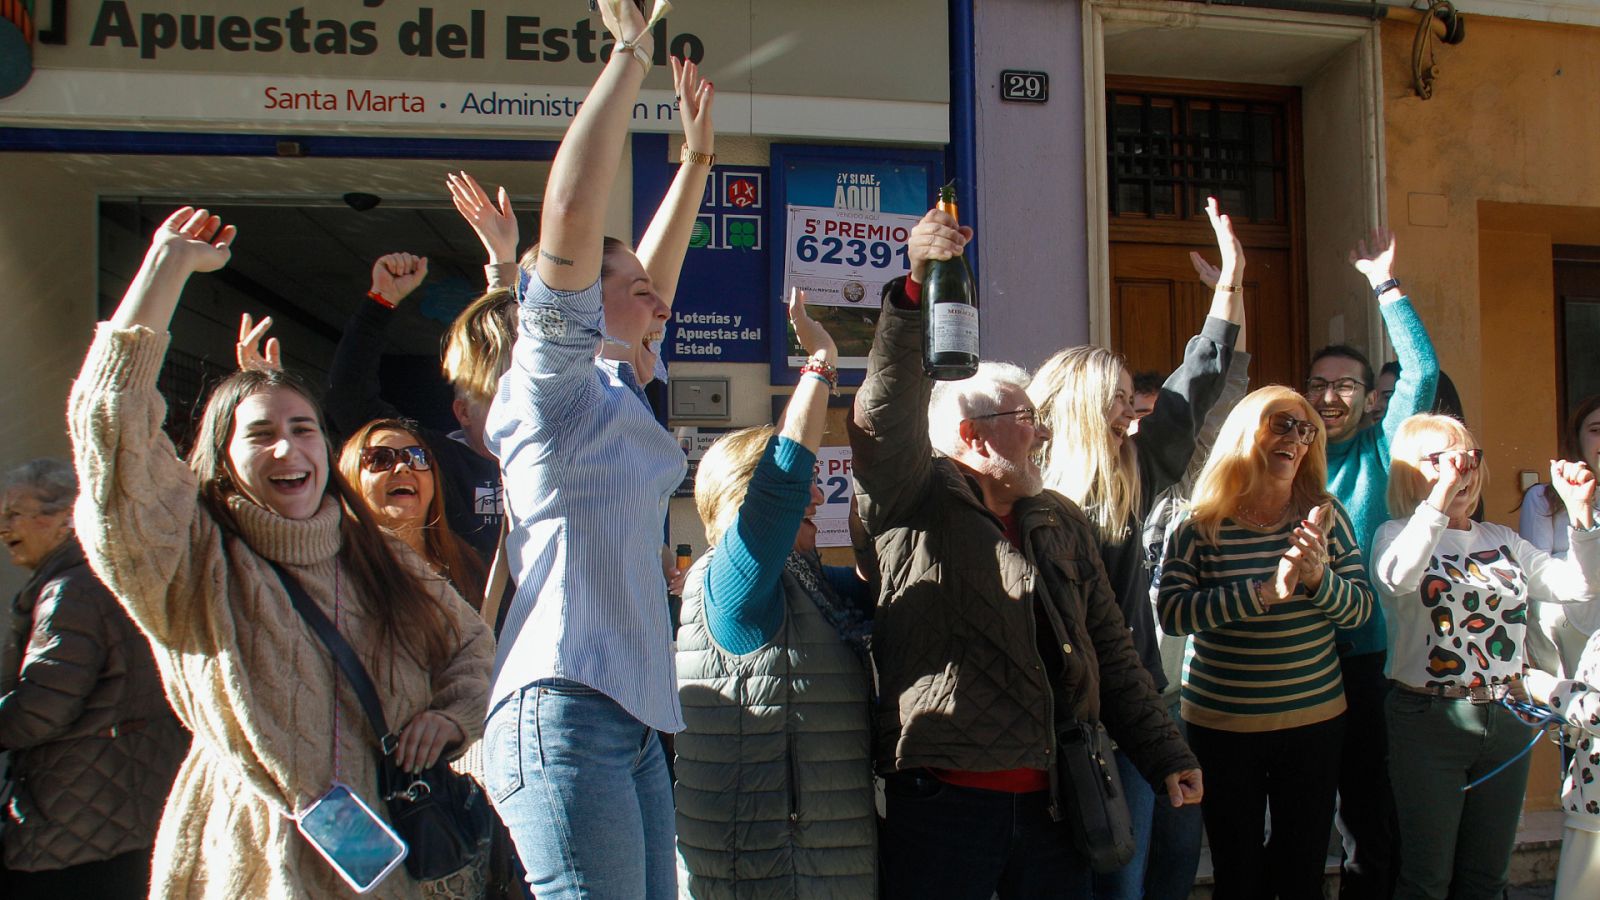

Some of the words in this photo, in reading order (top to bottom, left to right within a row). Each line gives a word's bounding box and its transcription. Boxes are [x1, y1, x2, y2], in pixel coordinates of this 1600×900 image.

[90, 1, 379, 59] Apuestas
[399, 8, 485, 59] del
[1010, 76, 1040, 97] 29
[264, 87, 337, 110] Santa
[347, 89, 425, 112] Marta
[460, 92, 648, 120] Administrn
[850, 174, 858, 185] SI
[860, 174, 875, 186] CAE
[804, 218, 821, 235] 5º
[825, 219, 909, 243] PREMIO
[796, 234, 911, 270] 62391
[675, 312, 731, 324] Loterías
[733, 314, 742, 327] y
[676, 327, 738, 341] Apuestas
[741, 328, 761, 340] del
[675, 343, 722, 355] Estado
